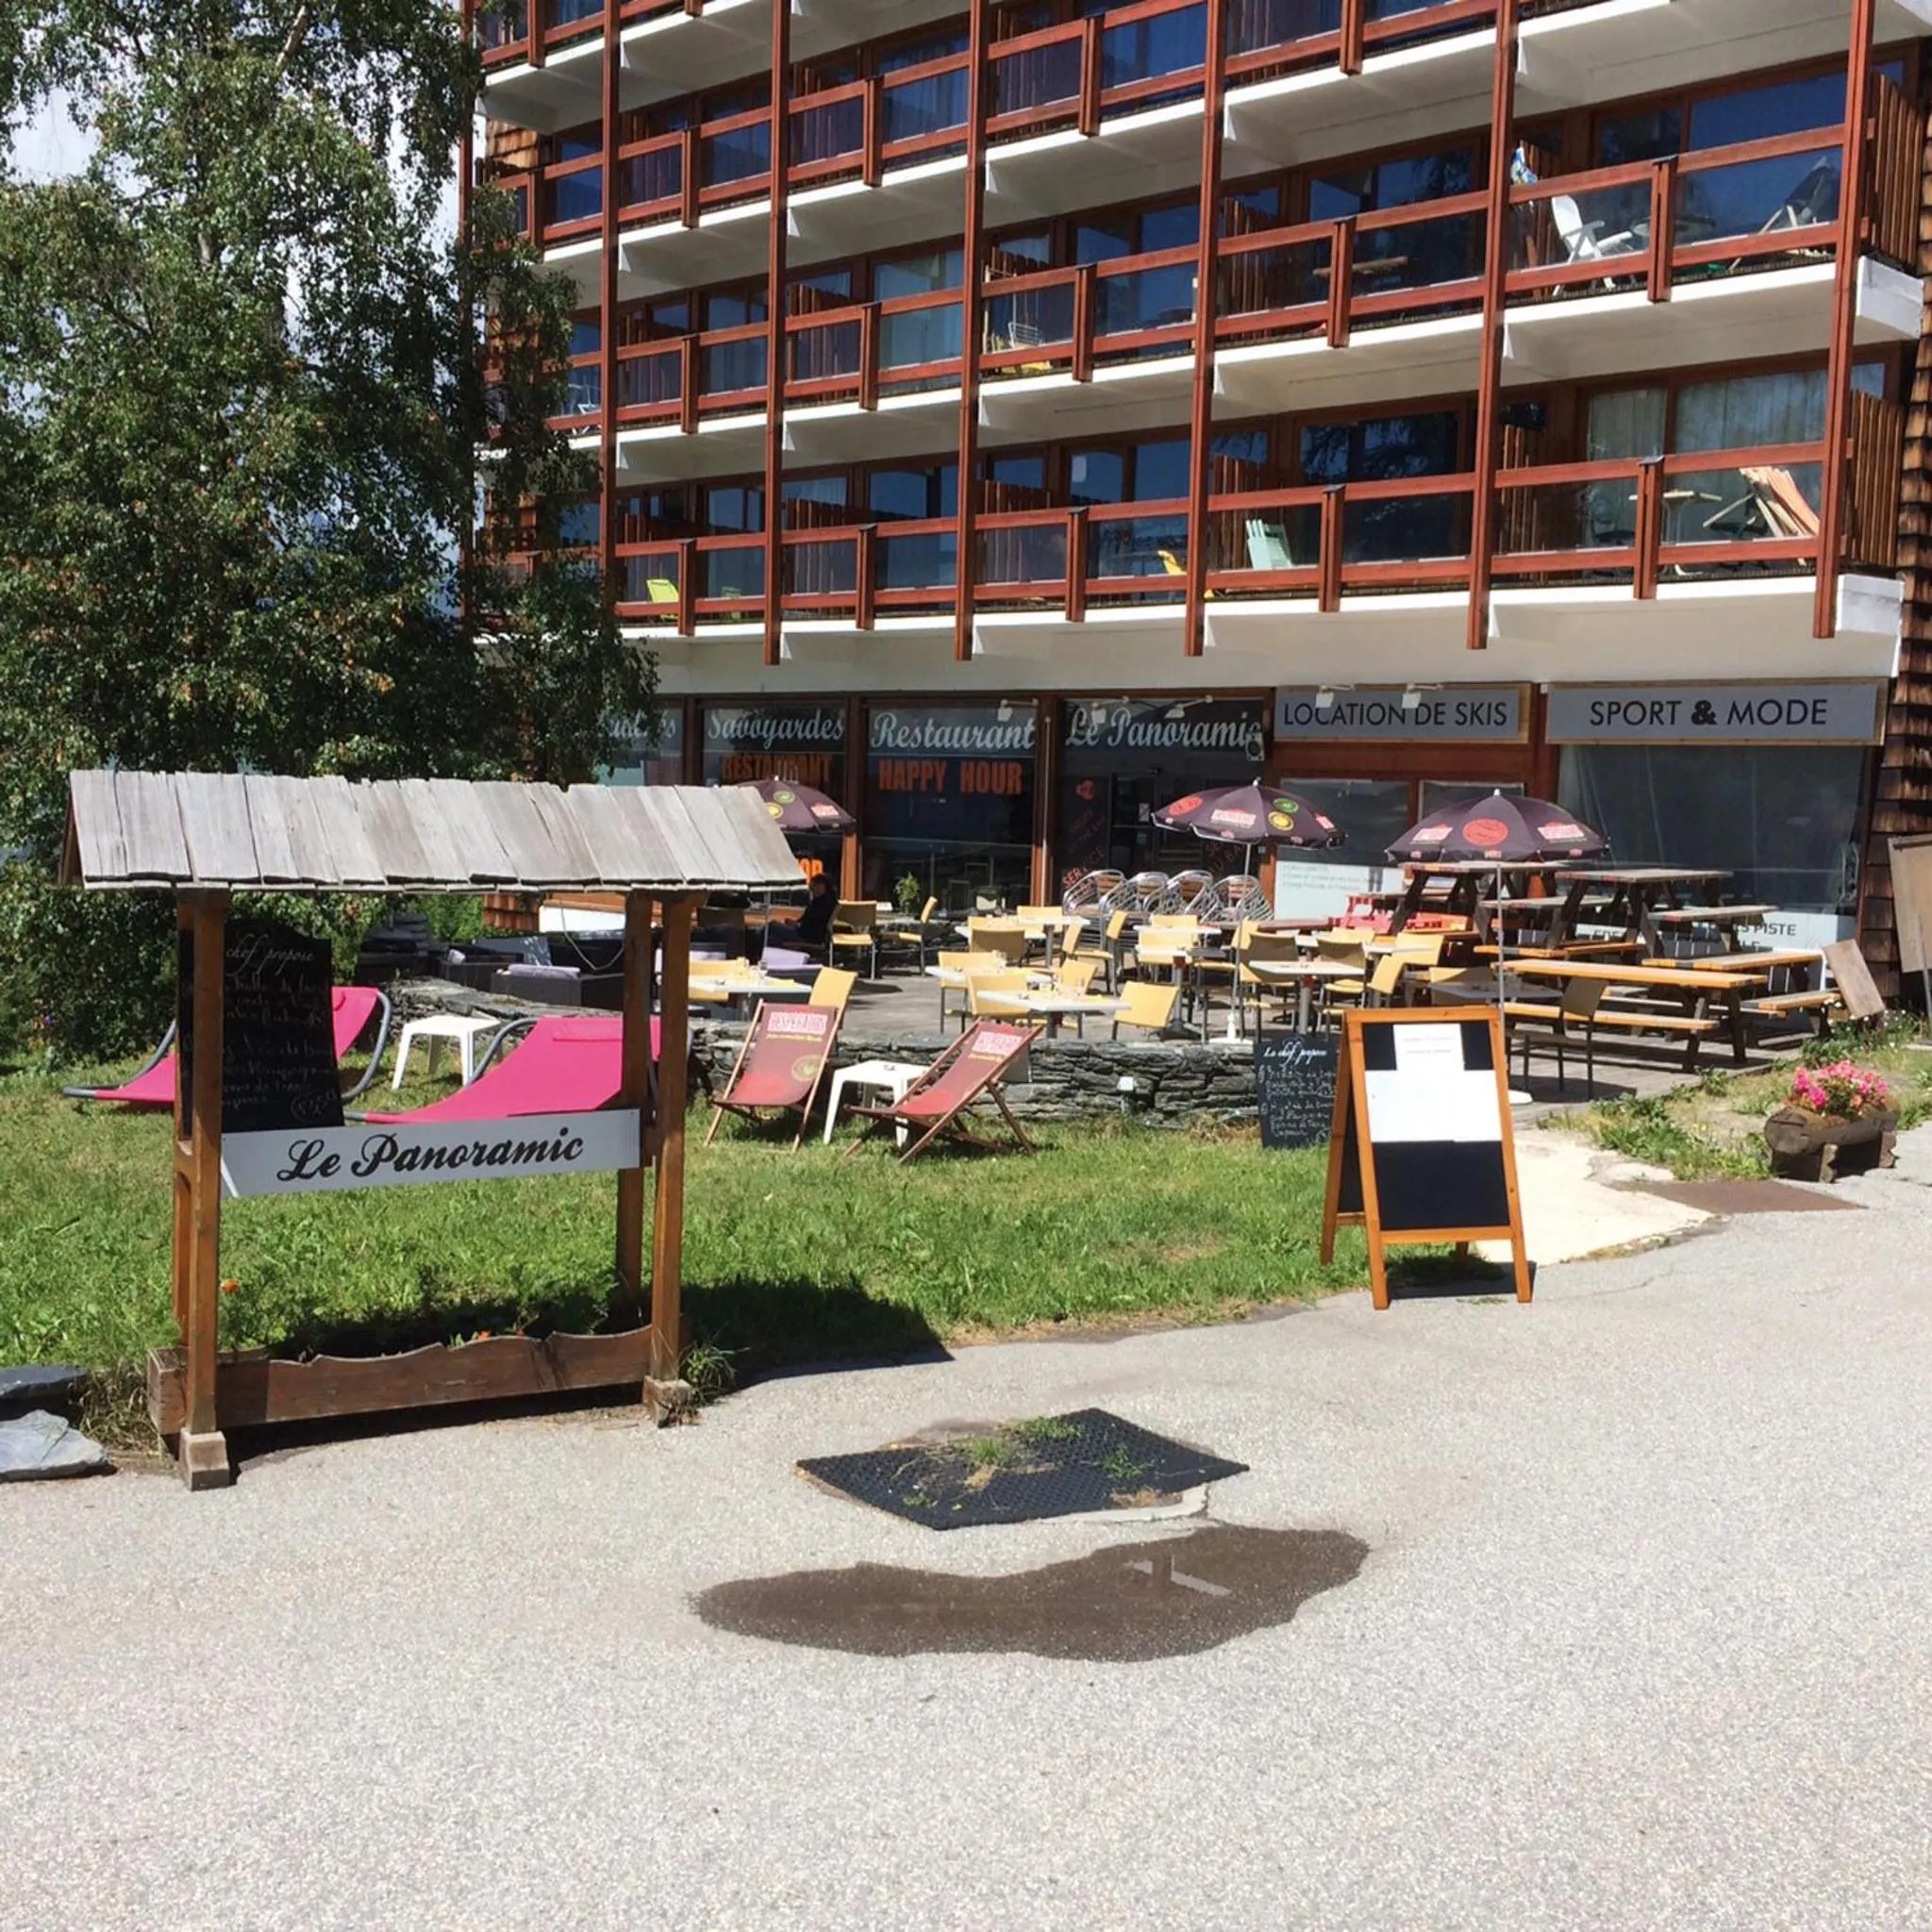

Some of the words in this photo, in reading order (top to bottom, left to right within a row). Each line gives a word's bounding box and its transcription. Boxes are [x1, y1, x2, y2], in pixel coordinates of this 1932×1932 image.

[708, 708, 846, 750] Savoyardes
[871, 712, 1036, 749] Restaurant
[1065, 708, 1100, 746] Le
[1107, 708, 1261, 748] Panoramic
[1284, 702, 1406, 726] LOCATION
[1416, 703, 1446, 726] DE
[1455, 702, 1507, 726] SKIS
[1590, 700, 1682, 725] SPORT
[1690, 699, 1717, 725] &
[1726, 699, 1828, 725] MODE
[878, 758, 947, 792] HAPPY
[959, 760, 1023, 795] HOUR
[276, 1139, 341, 1182] Le
[351, 1126, 584, 1176] Panoramic
